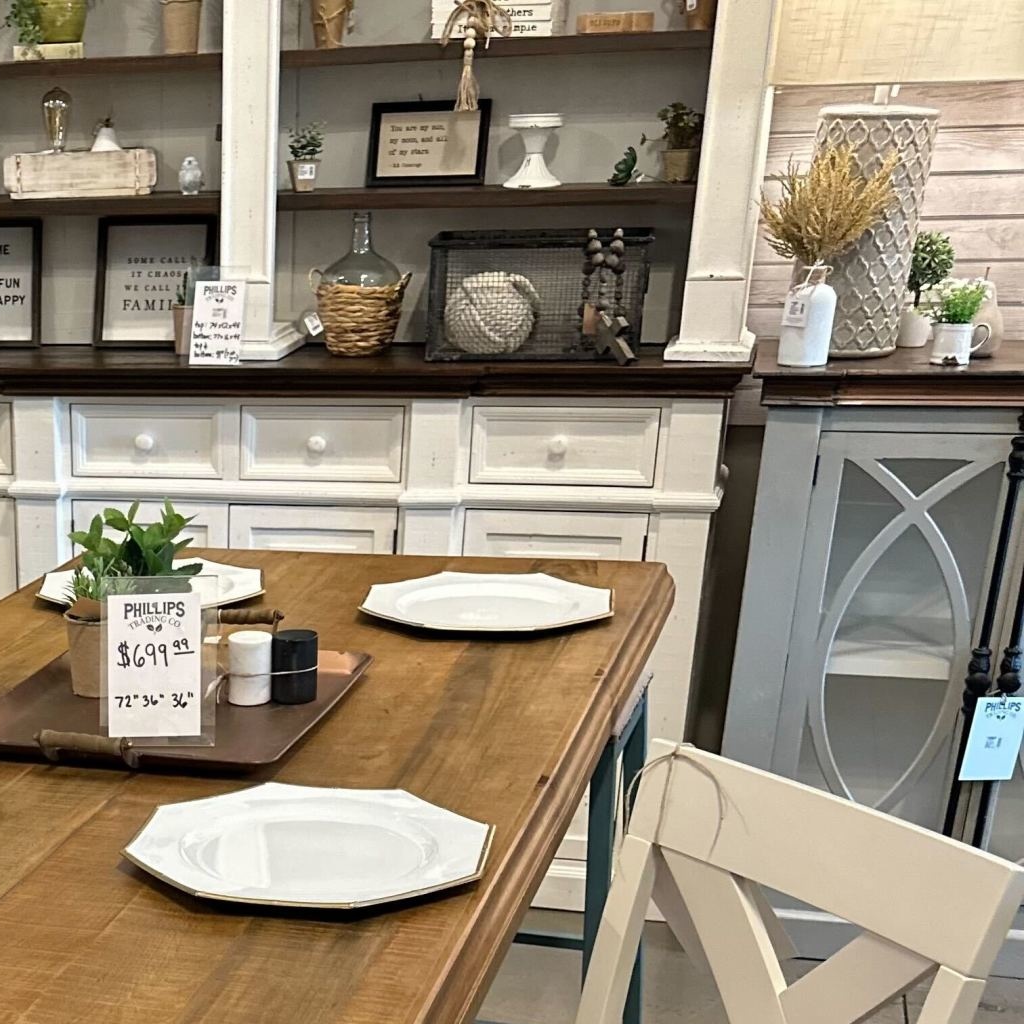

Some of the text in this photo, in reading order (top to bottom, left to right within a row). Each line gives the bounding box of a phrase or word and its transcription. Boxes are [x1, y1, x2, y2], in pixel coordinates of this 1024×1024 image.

[506, 8, 533, 17] thers
[127, 256, 187, 264] SOME CALL
[124, 284, 138, 292] WE
[144, 284, 171, 292] CALL
[204, 285, 237, 296] PHILLIPS
[124, 601, 185, 620] PHILLIPS
[128, 615, 167, 630] TRADING
[114, 691, 194, 708] 72" 36" 36"
[985, 702, 1022, 713] PHILLIPS
